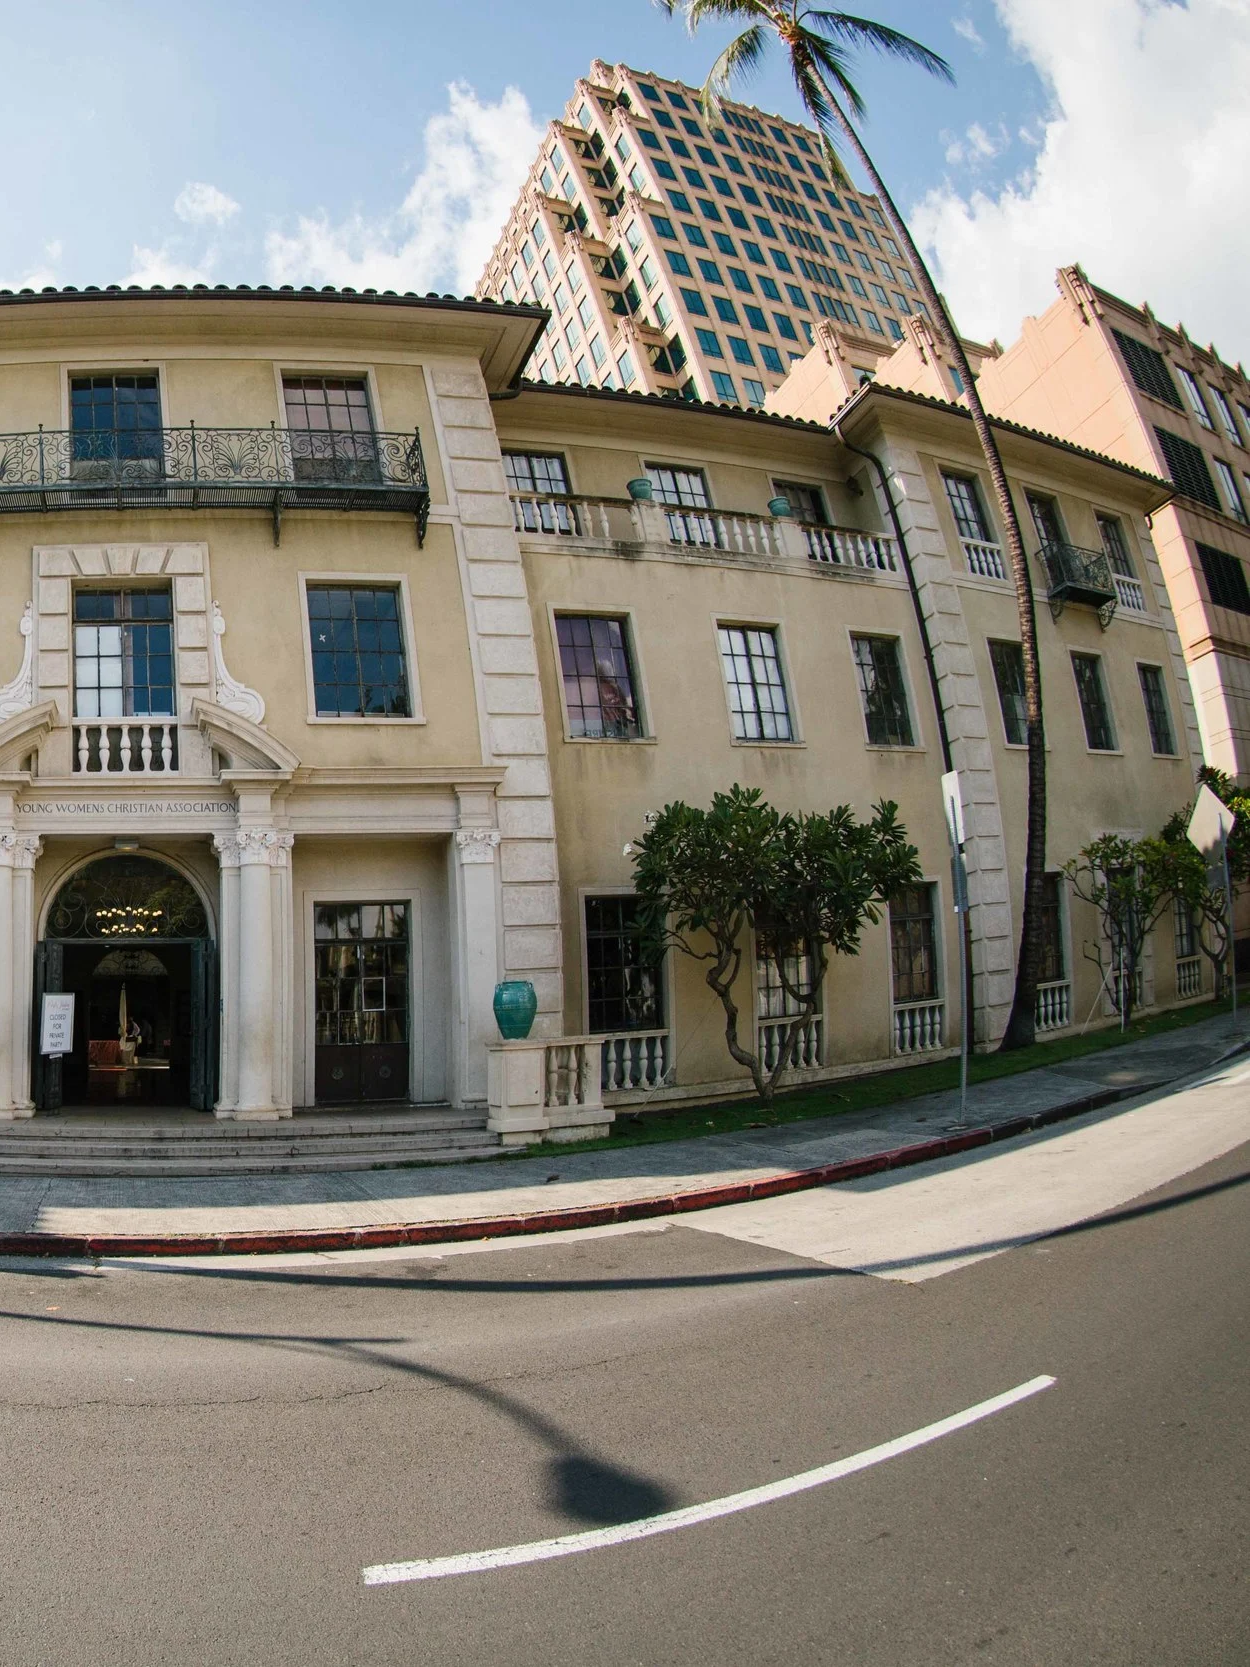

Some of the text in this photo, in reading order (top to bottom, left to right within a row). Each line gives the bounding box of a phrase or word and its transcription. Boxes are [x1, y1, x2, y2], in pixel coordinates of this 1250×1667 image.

[16, 802, 237, 814] YOUNG WOMENS CHRISTIAN ASSOCIATION
